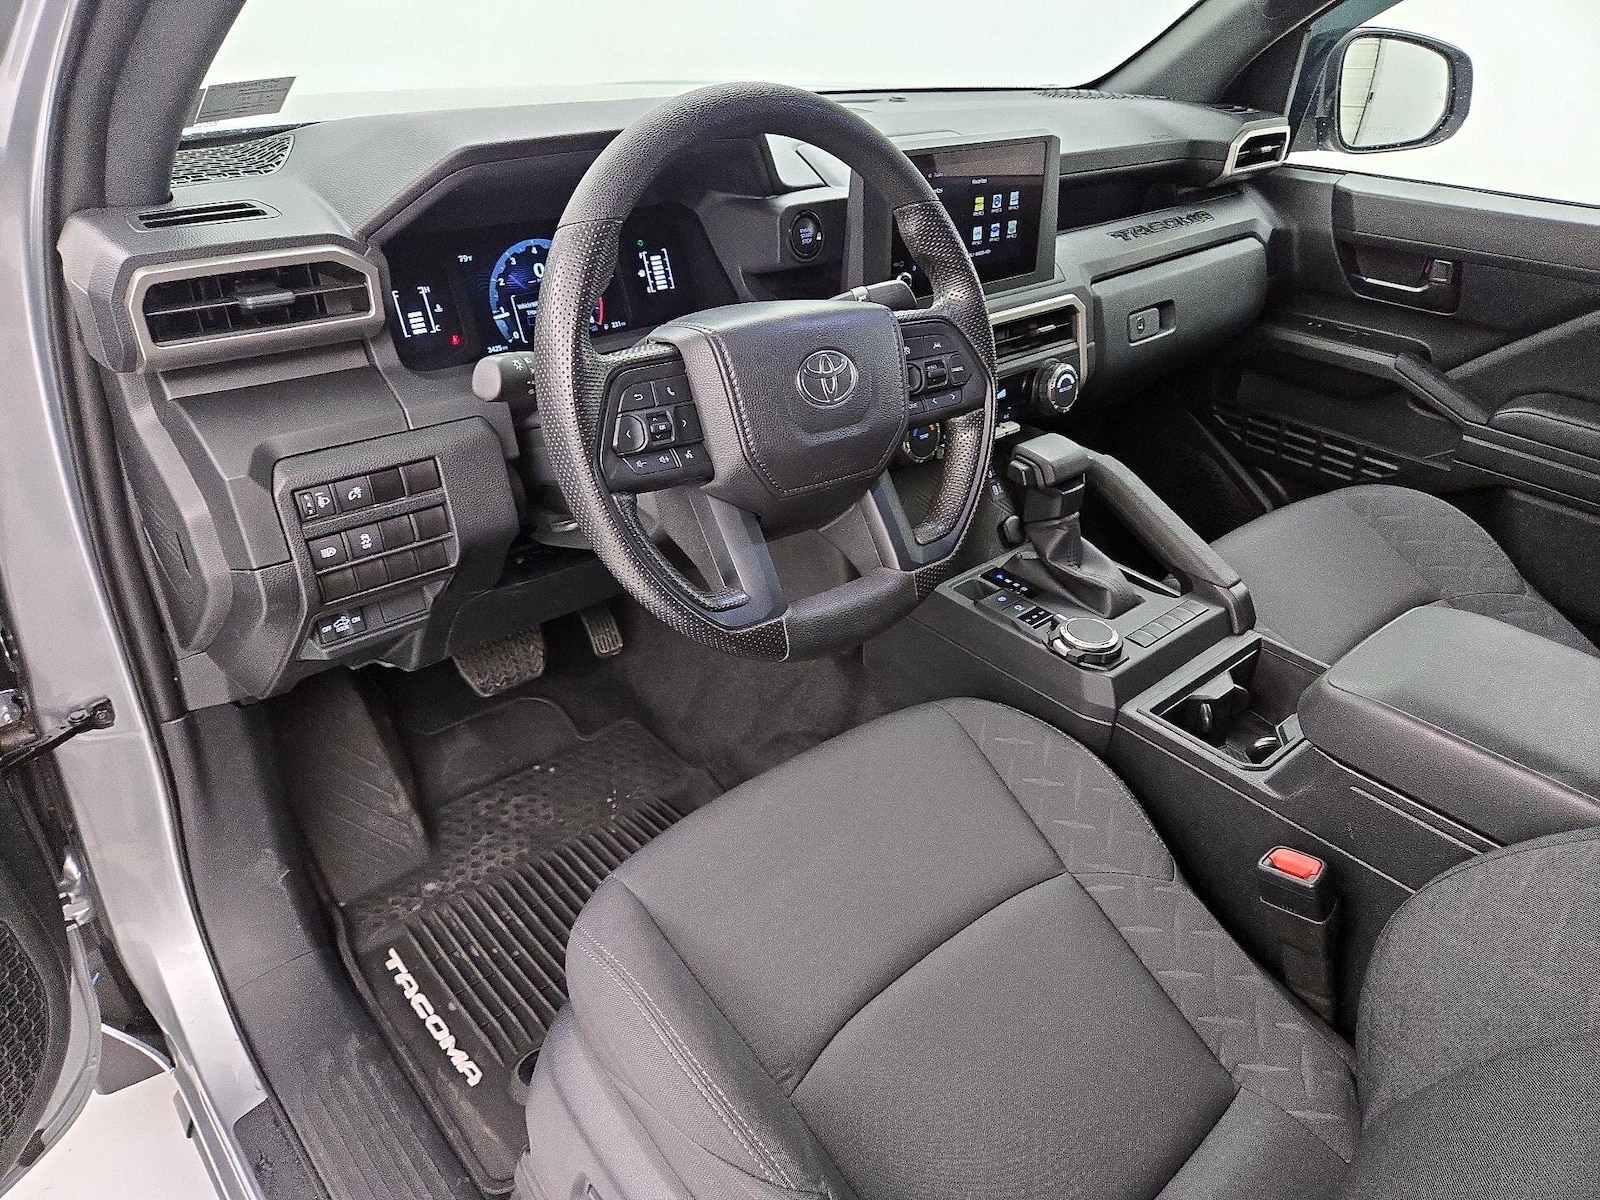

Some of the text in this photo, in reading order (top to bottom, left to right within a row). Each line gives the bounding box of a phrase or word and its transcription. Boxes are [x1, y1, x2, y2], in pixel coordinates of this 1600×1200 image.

[1106, 210, 1215, 241] TACOMA
[509, 256, 517, 265] 3
[533, 262, 545, 278] 0
[497, 277, 506, 286] 2
[512, 331, 520, 339] 0
[350, 615, 362, 624] ON
[321, 624, 333, 633] OFF
[384, 947, 483, 1087] TACOMA
